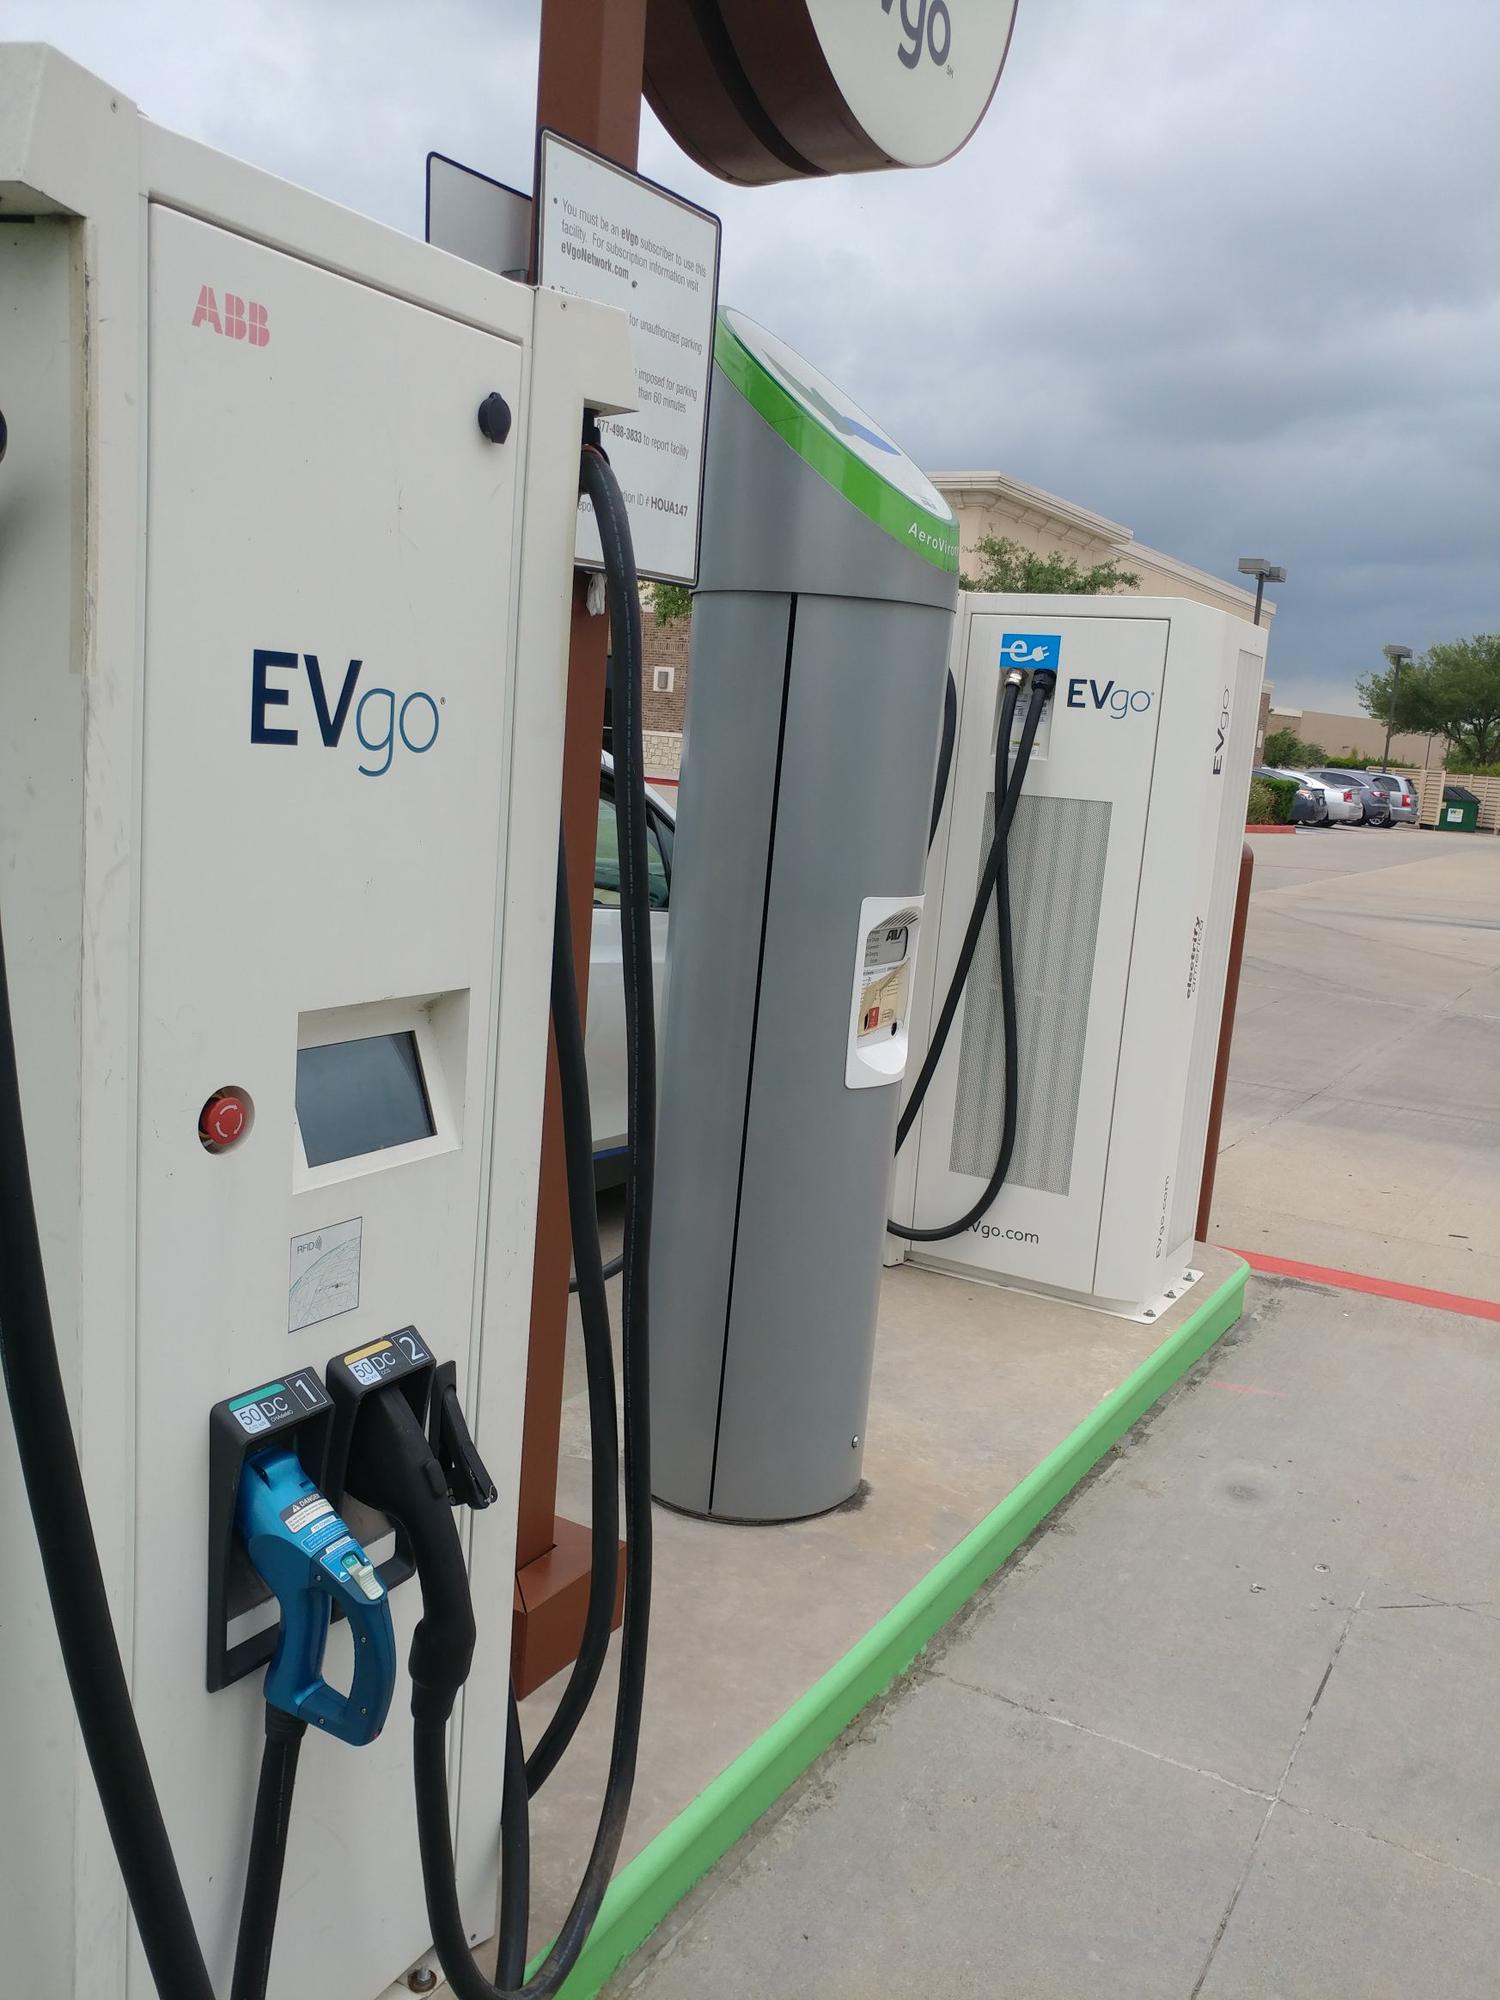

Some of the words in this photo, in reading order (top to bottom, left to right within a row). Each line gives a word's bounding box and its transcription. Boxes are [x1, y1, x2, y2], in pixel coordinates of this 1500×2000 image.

[881, 0, 951, 69] go
[562, 197, 577, 217] You
[579, 208, 599, 227] must
[601, 216, 609, 231] be
[611, 223, 619, 237] an
[621, 227, 639, 246] eVgo
[640, 238, 674, 262] subscriber
[676, 253, 682, 266] to
[683, 259, 695, 271] use
[695, 262, 706, 278] this
[561, 240, 629, 280] eVgoNetwork.com
[592, 231, 604, 249] For
[606, 241, 648, 270] subscription
[649, 261, 686, 286] information
[686, 278, 699, 292] visit
[192, 284, 271, 348] ABB
[629, 313, 639, 327] for
[640, 320, 681, 346] unauthorized
[681, 334, 703, 356] parking
[638, 368, 665, 388] imposed
[666, 377, 675, 391] for
[676, 383, 698, 402] parking
[639, 386, 652, 401] than
[653, 391, 662, 405] 60
[662, 396, 687, 414] minutes
[643, 433, 650, 446] to
[651, 436, 669, 451] report
[670, 439, 690, 460] facility
[637, 493, 644, 506] ID
[651, 496, 688, 517] HOUA147
[250, 648, 440, 778] EVgo
[1066, 678, 1151, 720] EVgo
[1212, 688, 1229, 775] EVgo
[297, 1241, 315, 1255] RFID
[965, 1220, 1039, 1244] Vgo.com
[354, 1360, 374, 1379] 50
[372, 1351, 396, 1371] DC
[399, 1335, 425, 1361] 2
[294, 1378, 318, 1404] 1
[240, 1407, 262, 1426] 50
[260, 1396, 289, 1417] DC
